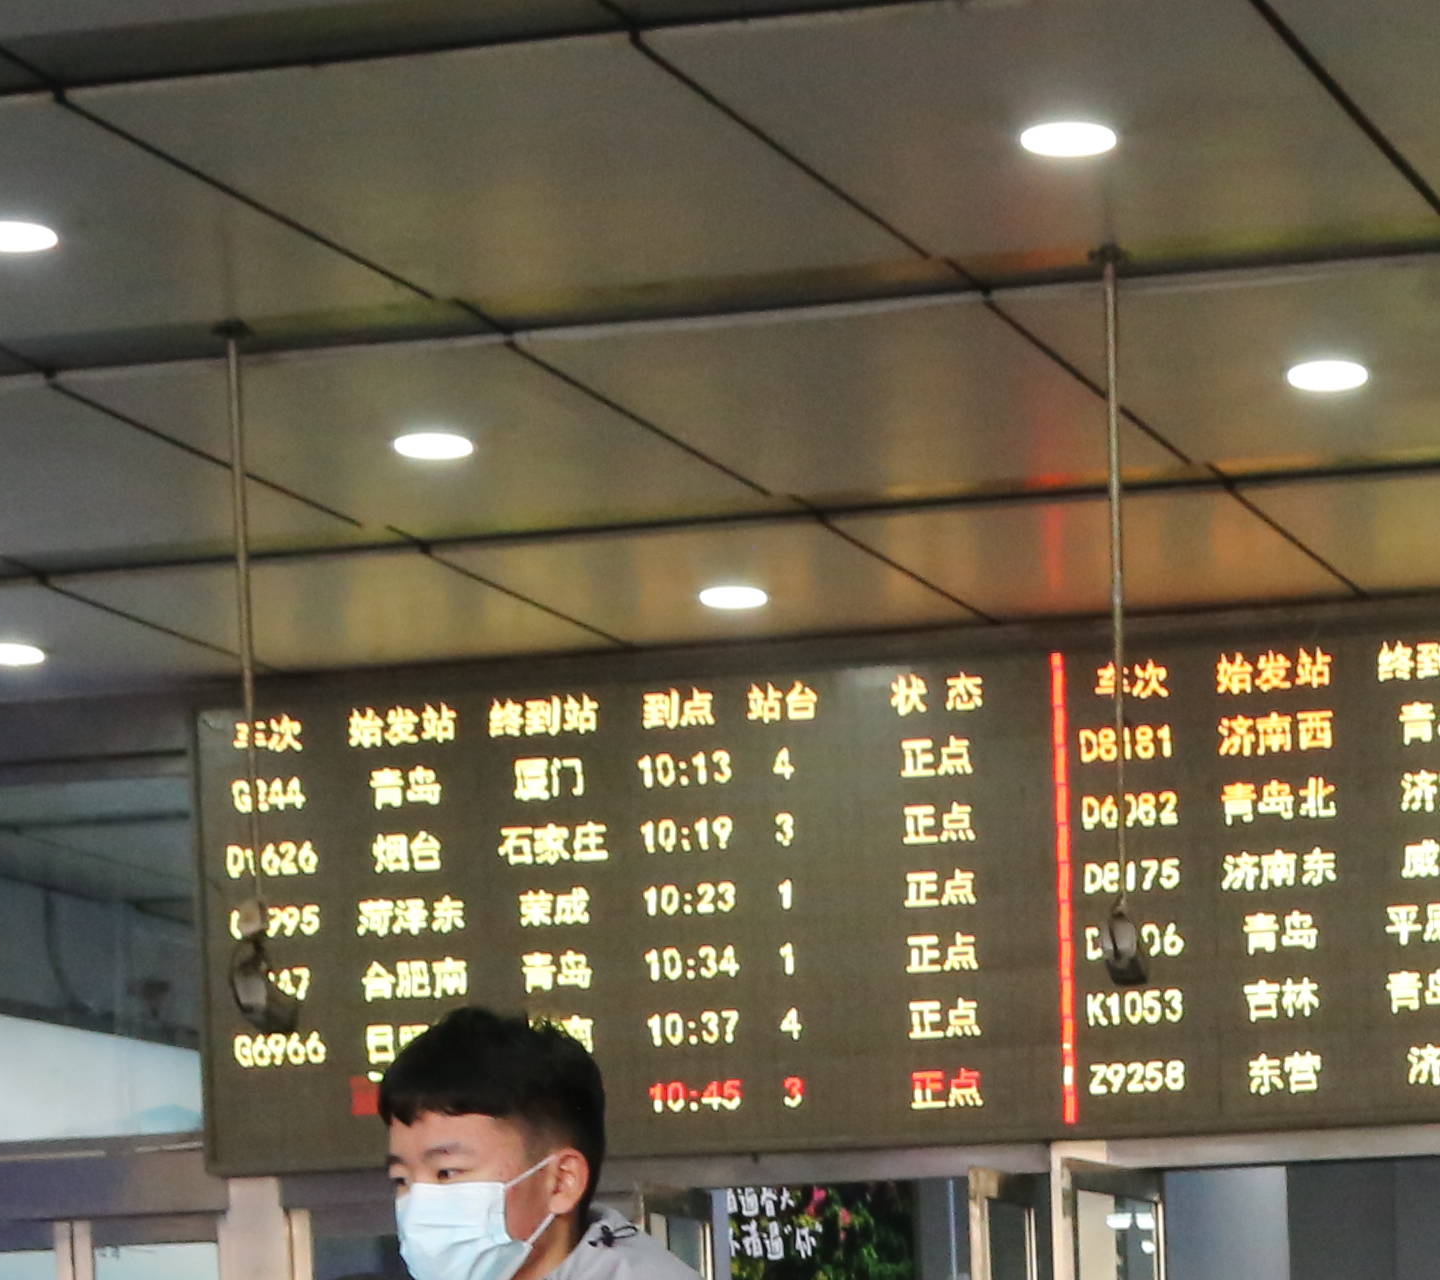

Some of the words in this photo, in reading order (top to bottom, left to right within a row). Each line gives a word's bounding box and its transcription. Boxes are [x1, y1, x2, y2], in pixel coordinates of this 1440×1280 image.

[1094, 658, 1169, 699] 车次
[1216, 647, 1332, 695] 始发站
[232, 714, 303, 753] 车次
[348, 702, 457, 749] 始发站
[488, 693, 599, 738] 终到站
[642, 687, 715, 730] 到点
[746, 680, 818, 724] 站台
[1217, 709, 1334, 757] 济南西
[369, 765, 442, 810] 青岛
[513, 757, 584, 802] 厦门
[637, 749, 732, 788] 10:13
[772, 746, 795, 780] 4
[900, 734, 973, 778] 正点
[1220, 776, 1337, 826] 青岛北
[372, 830, 441, 873] 烟台
[497, 820, 609, 866] 石家庄
[640, 815, 733, 854] 10:19
[775, 812, 794, 847] 3
[902, 801, 976, 845] 正点
[1221, 846, 1337, 892] 济南东
[356, 894, 465, 937] 菏泽东
[519, 886, 590, 927] 荣成
[643, 880, 736, 916] 10:23
[778, 879, 793, 910] 1
[903, 868, 977, 908] 正点
[1242, 909, 1318, 955] 青岛
[361, 956, 468, 1002] 合肥南
[521, 949, 593, 994] 青岛
[644, 944, 740, 981] 10:34
[779, 942, 795, 975] 1
[905, 931, 979, 974] 正点
[1086, 988, 1183, 1027] K1053
[1243, 976, 1319, 1023] 吉林
[234, 1031, 327, 1068] G6966
[366, 1024, 429, 1065] 日
[647, 1009, 739, 1047] 10:37
[779, 1007, 802, 1040] 4
[908, 996, 982, 1040] 正点
[648, 1078, 743, 1113] 10:45
[783, 1076, 805, 1108] 3
[911, 1067, 984, 1110] 正点
[1088, 1059, 1185, 1095] Z9258
[1248, 1050, 1322, 1096] 东营
